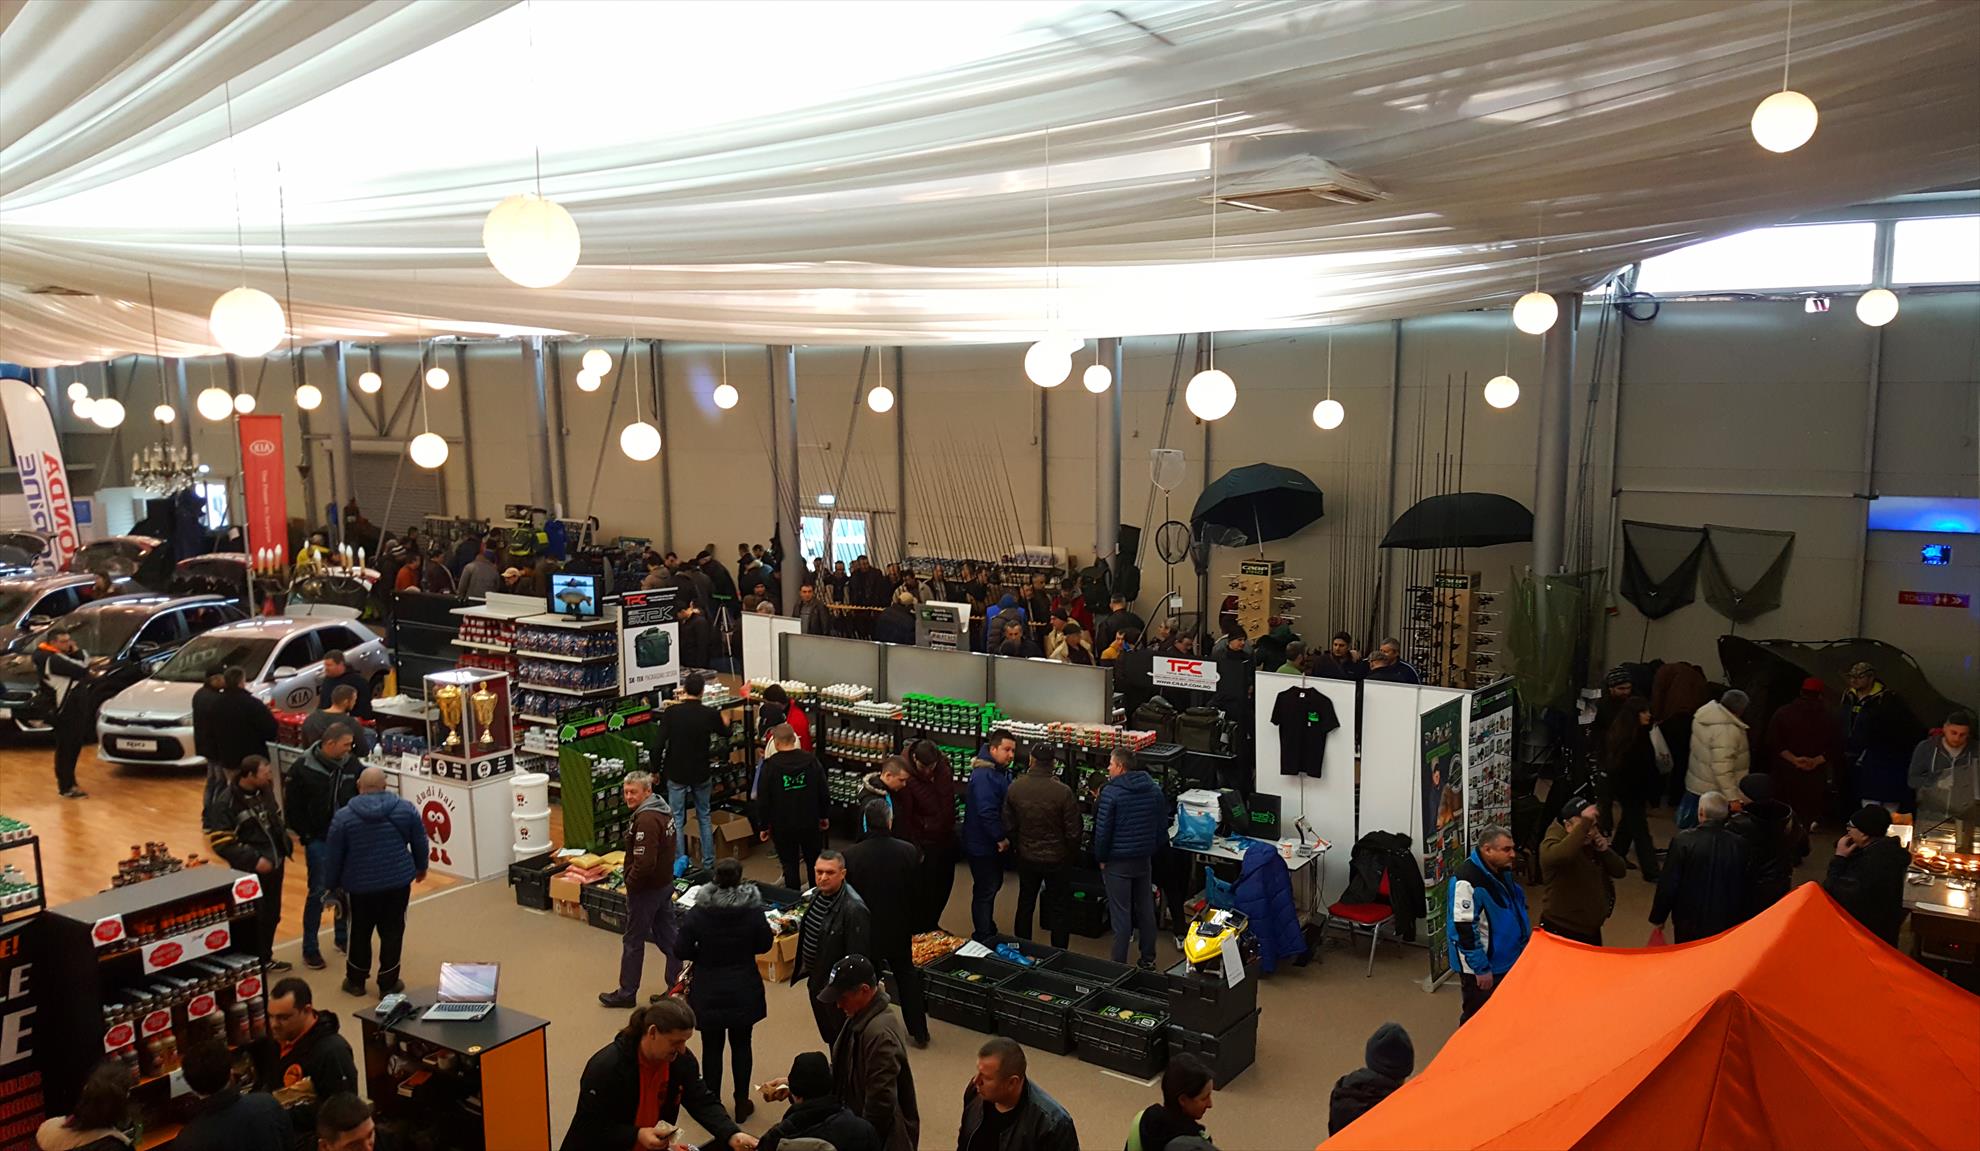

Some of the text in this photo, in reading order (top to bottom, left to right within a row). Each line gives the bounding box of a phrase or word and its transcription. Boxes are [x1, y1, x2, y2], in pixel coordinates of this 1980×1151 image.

[1167, 659, 1203, 675] TPC
[291, 690, 309, 705] KIA
[416, 786, 456, 812] dudi bait
